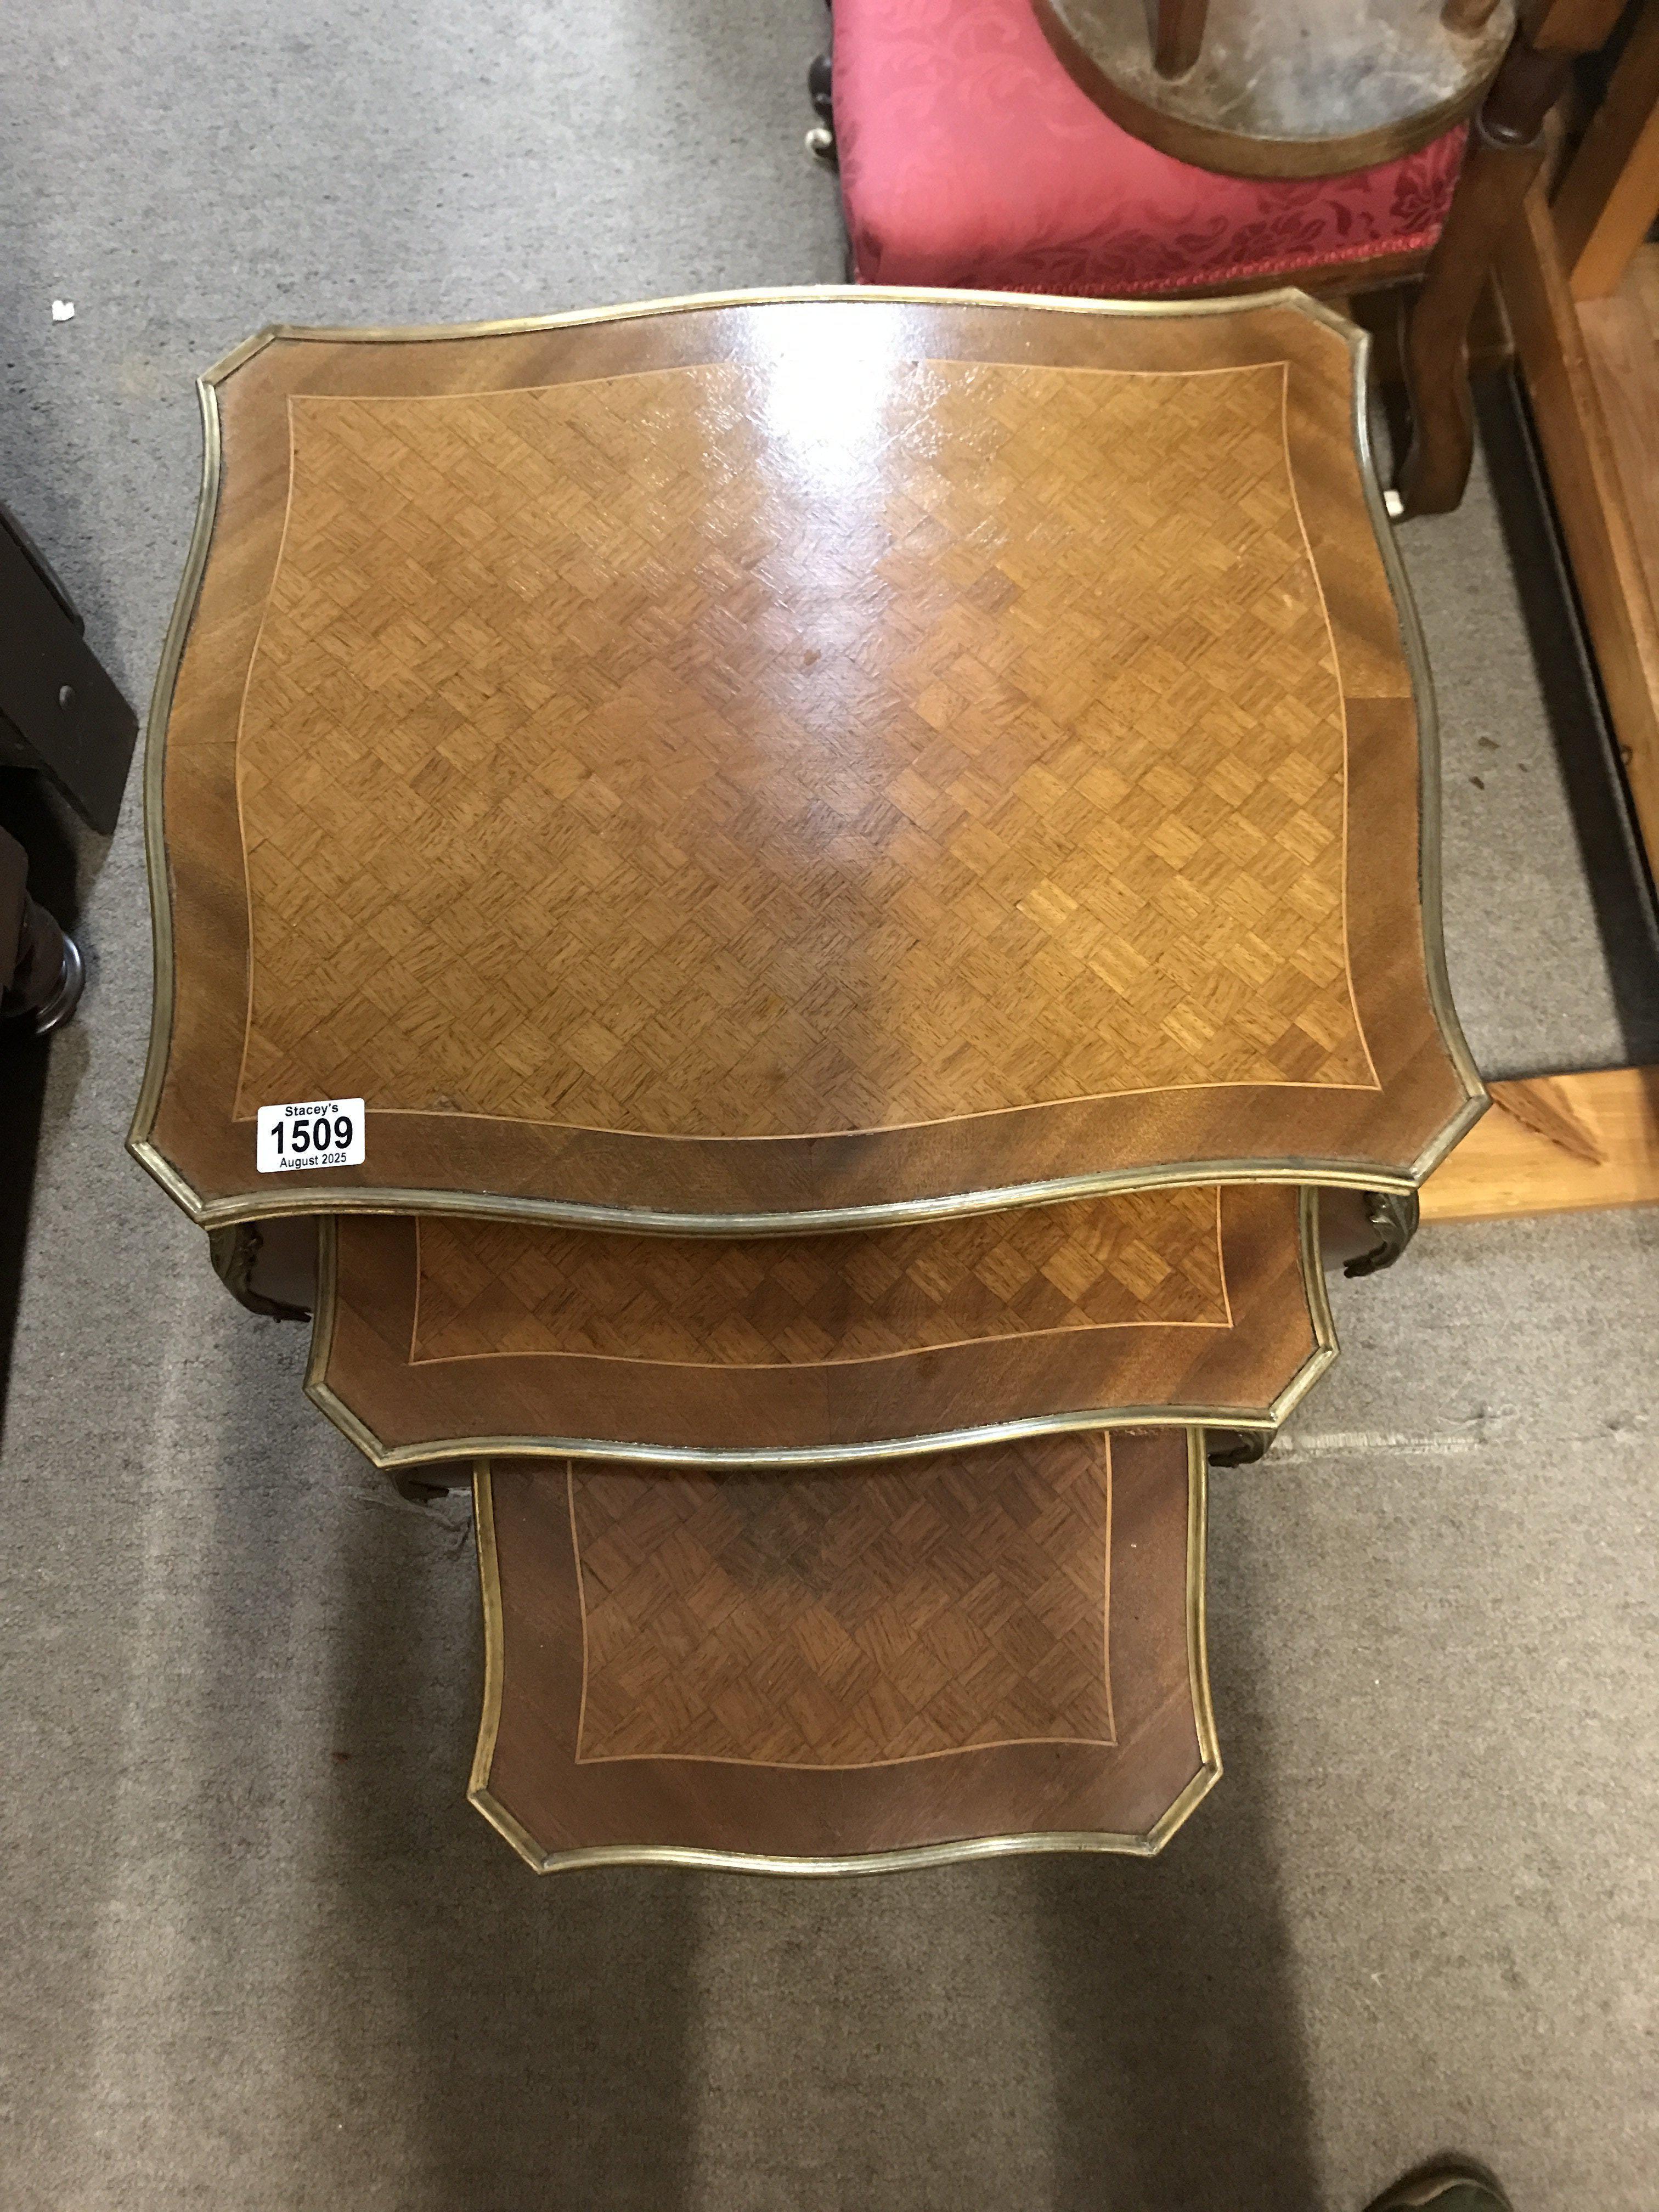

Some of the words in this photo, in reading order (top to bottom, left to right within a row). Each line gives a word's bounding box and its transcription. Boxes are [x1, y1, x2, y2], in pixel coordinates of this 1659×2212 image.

[285, 1103, 338, 1116] Stacey's
[271, 1116, 353, 1154] 1509
[280, 1155, 318, 1169] August
[321, 1153, 347, 1164] 2025
